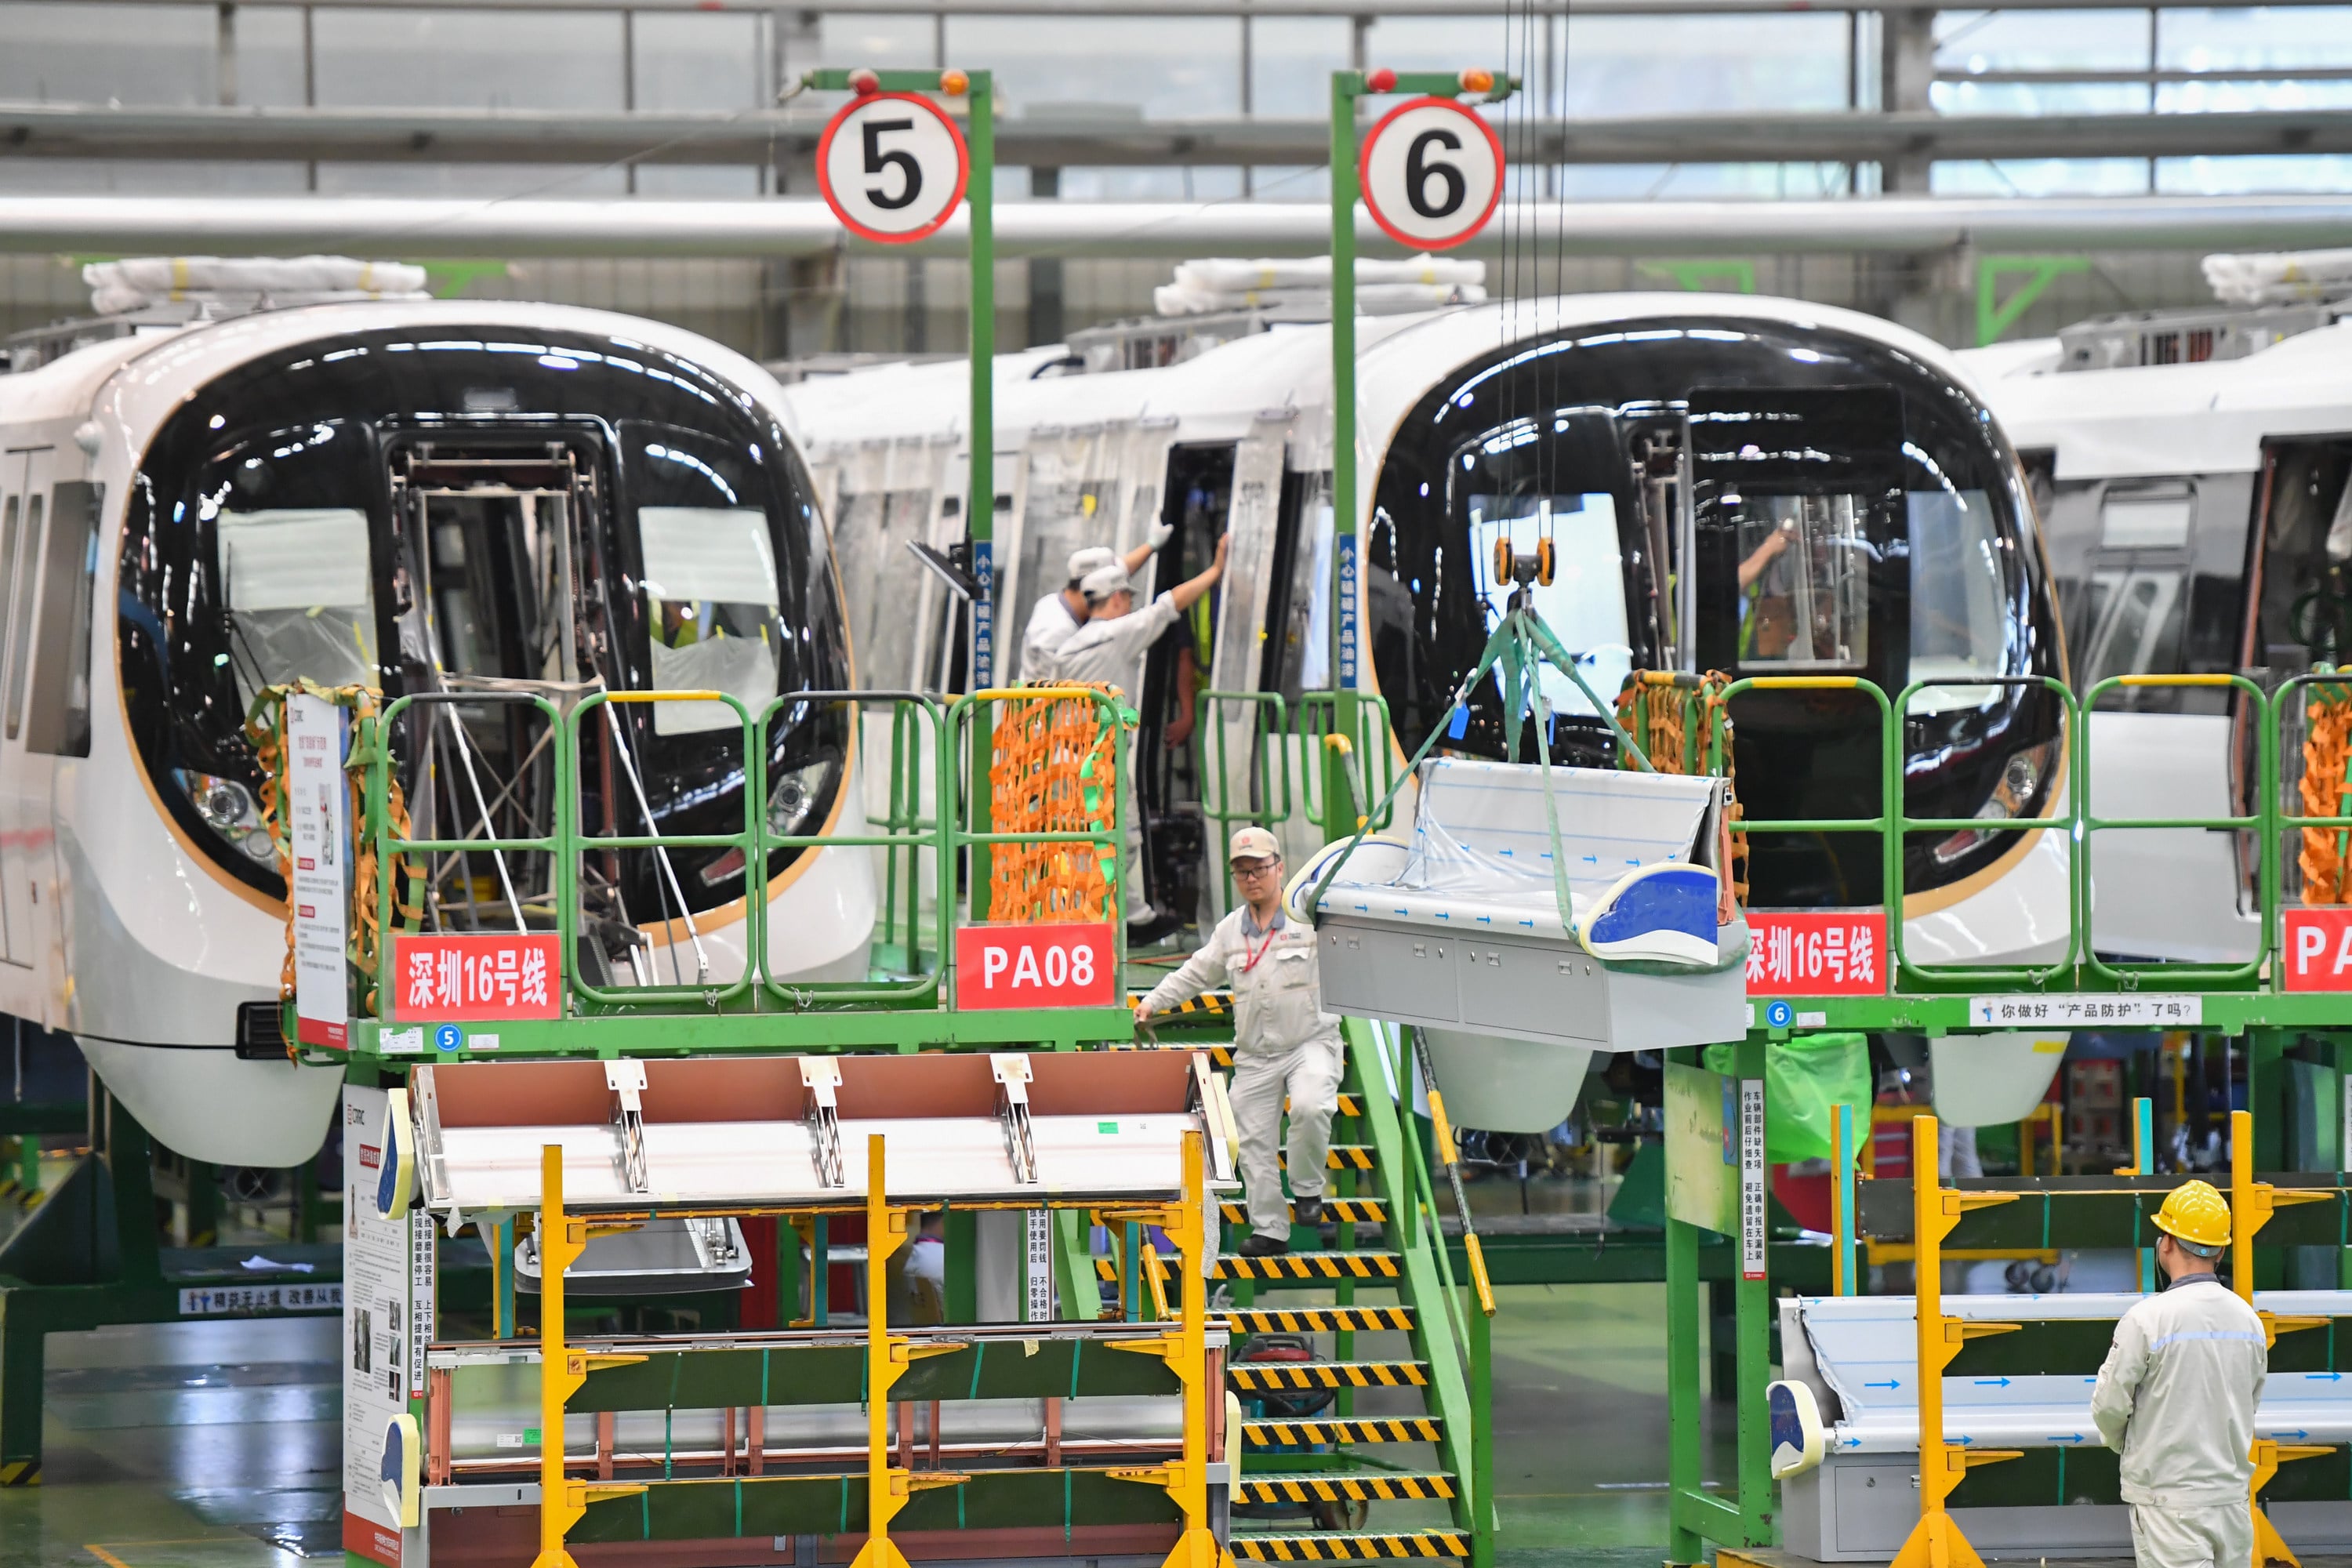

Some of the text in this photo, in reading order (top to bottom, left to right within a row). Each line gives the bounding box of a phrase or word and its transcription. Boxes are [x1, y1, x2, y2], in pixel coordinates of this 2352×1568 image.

[862, 119, 924, 210] 5
[1405, 129, 1466, 219] 6
[408, 948, 548, 1009] 深圳16号线
[984, 945, 1094, 989] PA08
[444, 1030, 455, 1046] 5
[1774, 1007, 1785, 1022] 6
[1753, 1091, 1763, 1260] 车辆部件缺失项 正确申报无漏装
[1745, 1182, 1754, 1261] 避免遗留在车上
